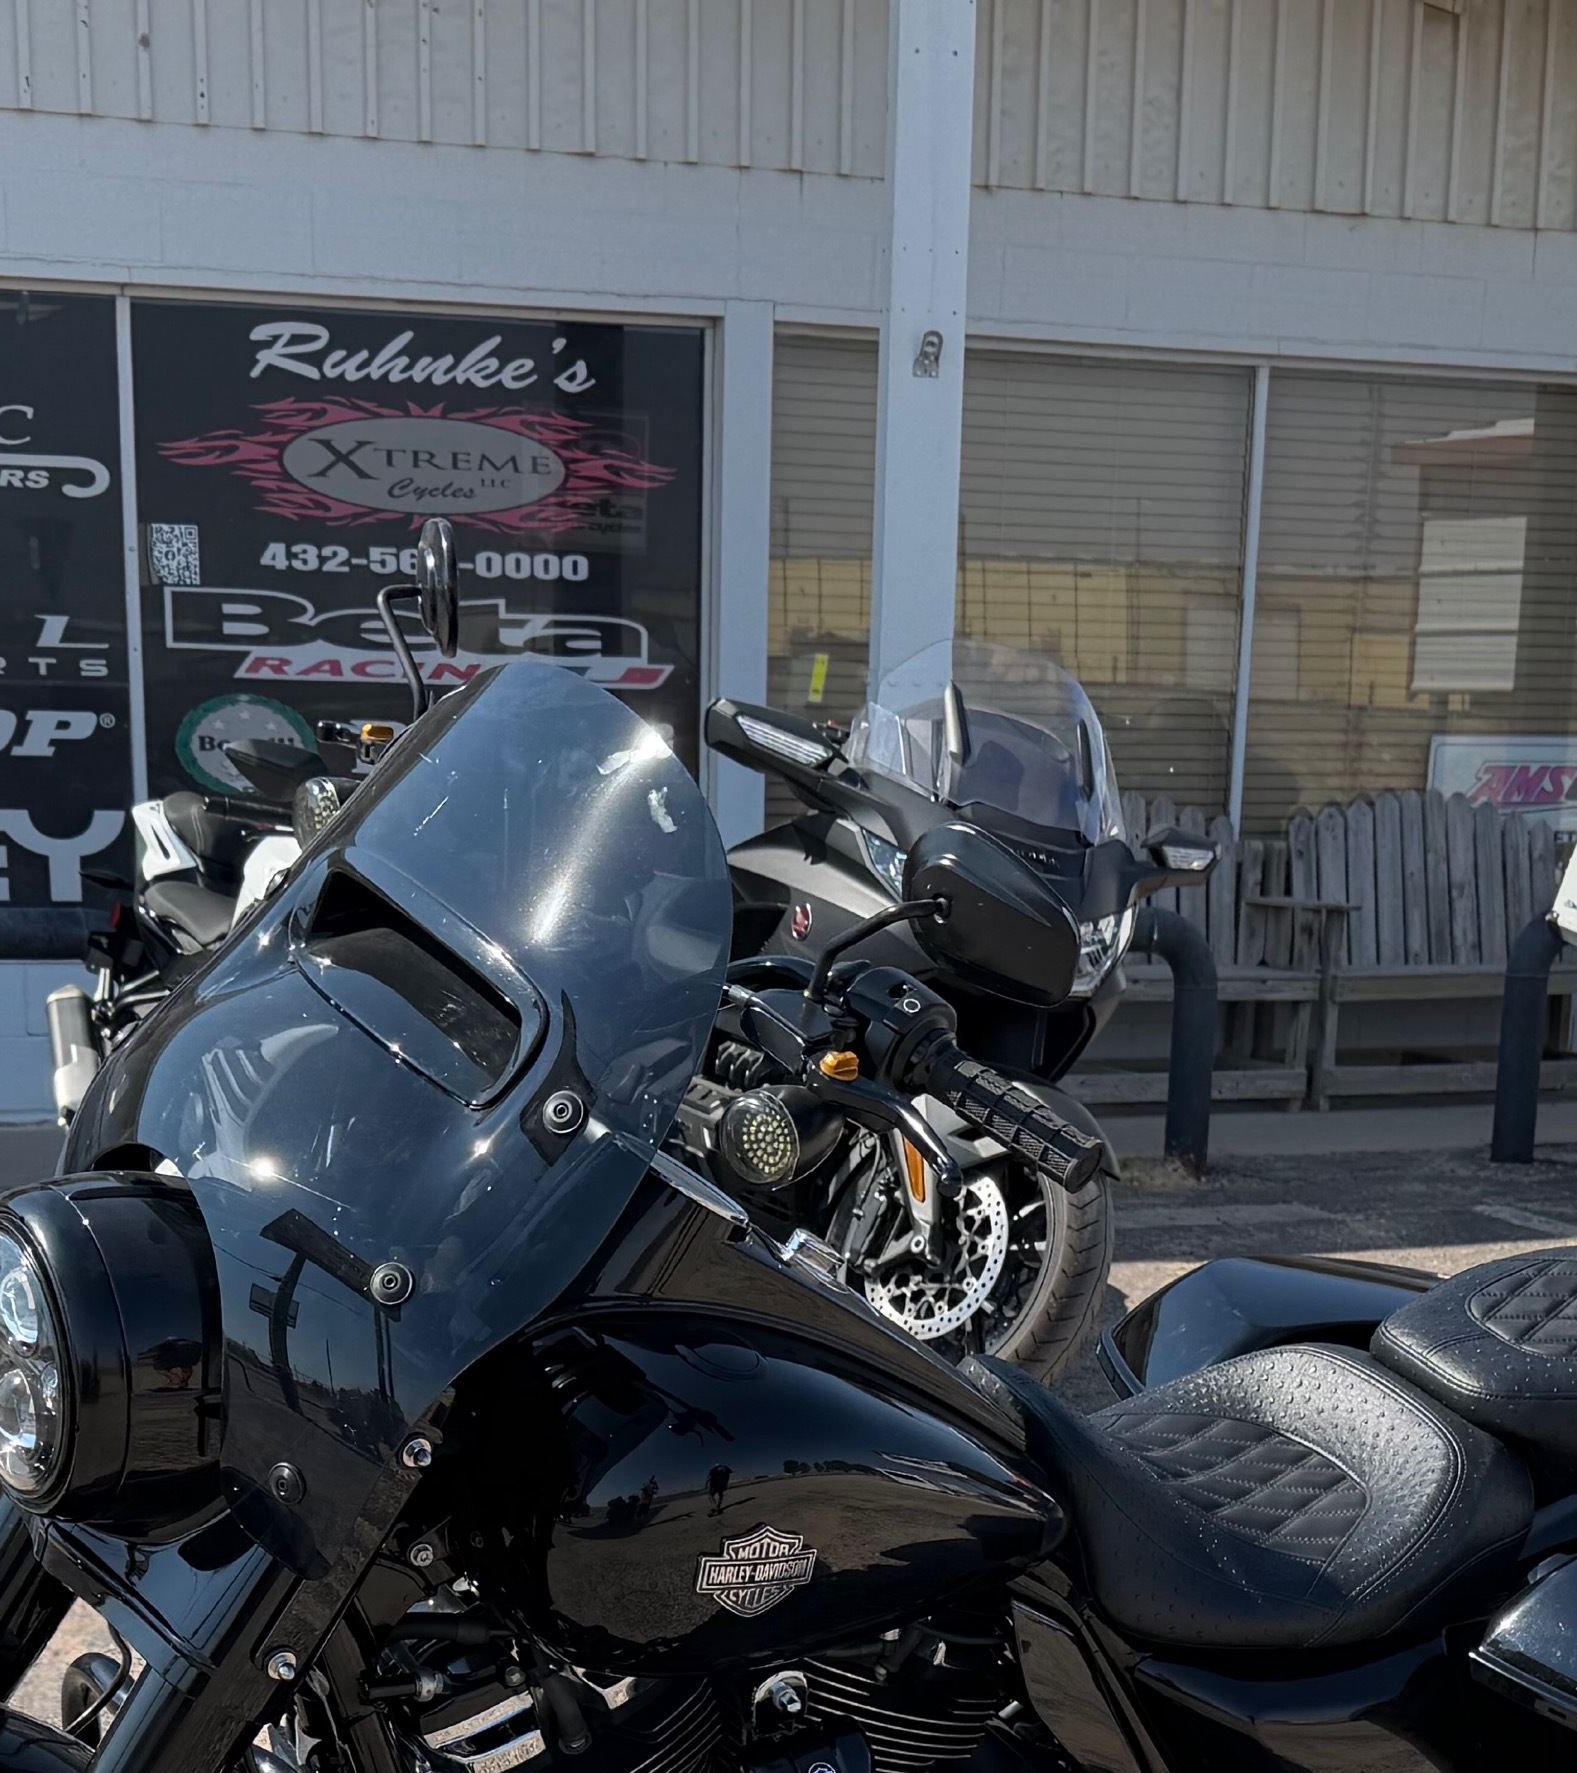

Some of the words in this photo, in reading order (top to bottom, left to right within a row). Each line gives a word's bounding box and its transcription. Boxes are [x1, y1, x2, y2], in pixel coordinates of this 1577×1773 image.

[249, 321, 597, 394] Ruhnke's
[307, 438, 552, 480] XTREME
[387, 477, 477, 502] Cycles
[481, 478, 512, 489] LLC
[260, 542, 590, 581] 432-56-0000
[163, 586, 649, 665] Beta
[243, 656, 484, 681] RACN
[737, 1538, 790, 1560] MOTOR
[708, 1559, 808, 1585] HARLEY-DAVIDSON
